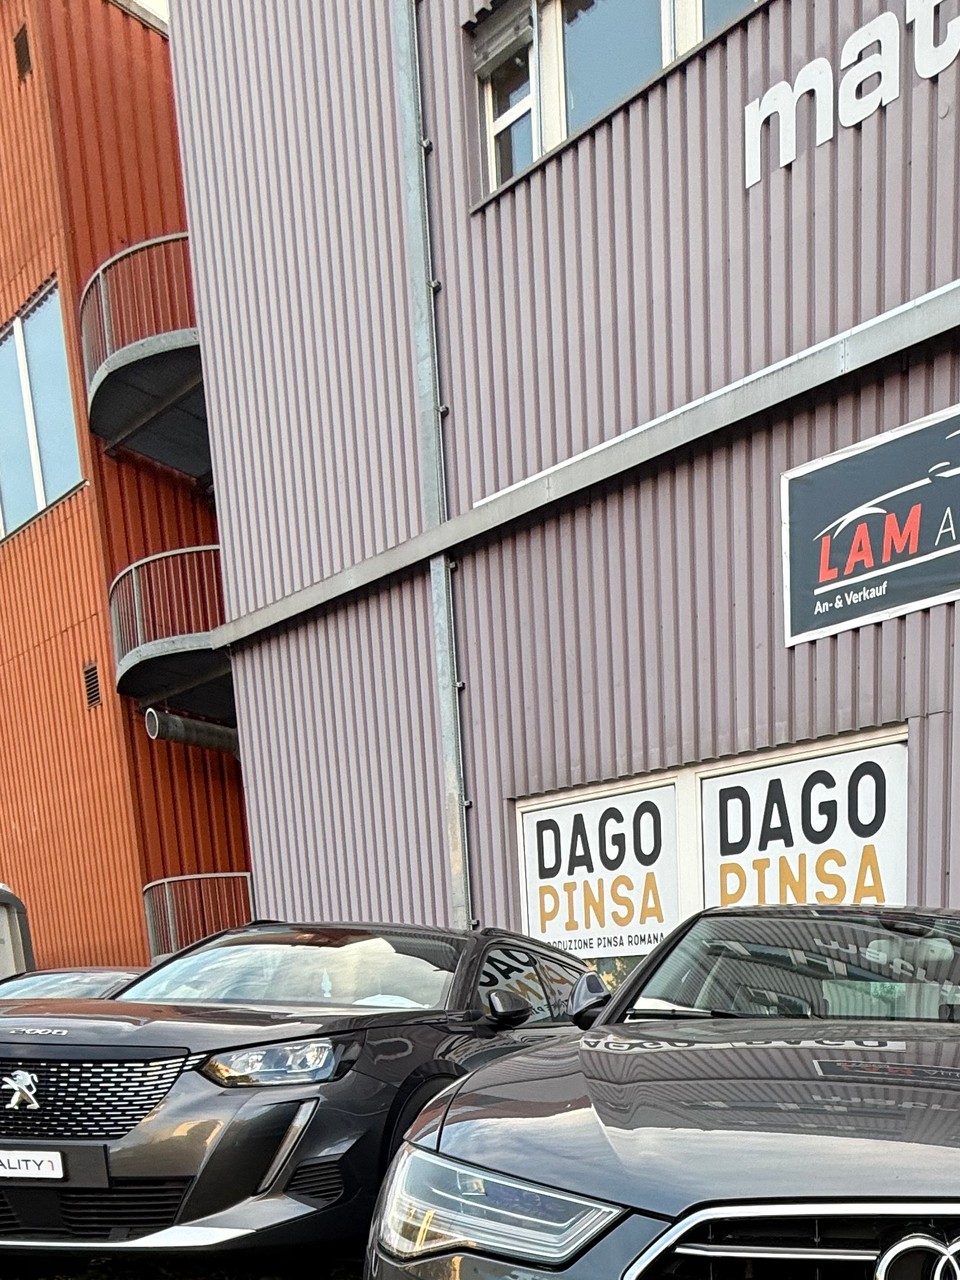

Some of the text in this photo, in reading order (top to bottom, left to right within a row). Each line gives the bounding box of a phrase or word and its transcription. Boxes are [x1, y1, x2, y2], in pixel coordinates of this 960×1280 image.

[818, 503, 922, 583] LAM
[844, 580, 888, 606] Verkauf
[536, 800, 662, 880] DAGO
[718, 760, 887, 857] DAGO
[538, 871, 664, 934] PINSA
[719, 844, 886, 907] PINSA
[597, 935, 625, 948] PINSA
[627, 932, 665, 946] ROMANA
